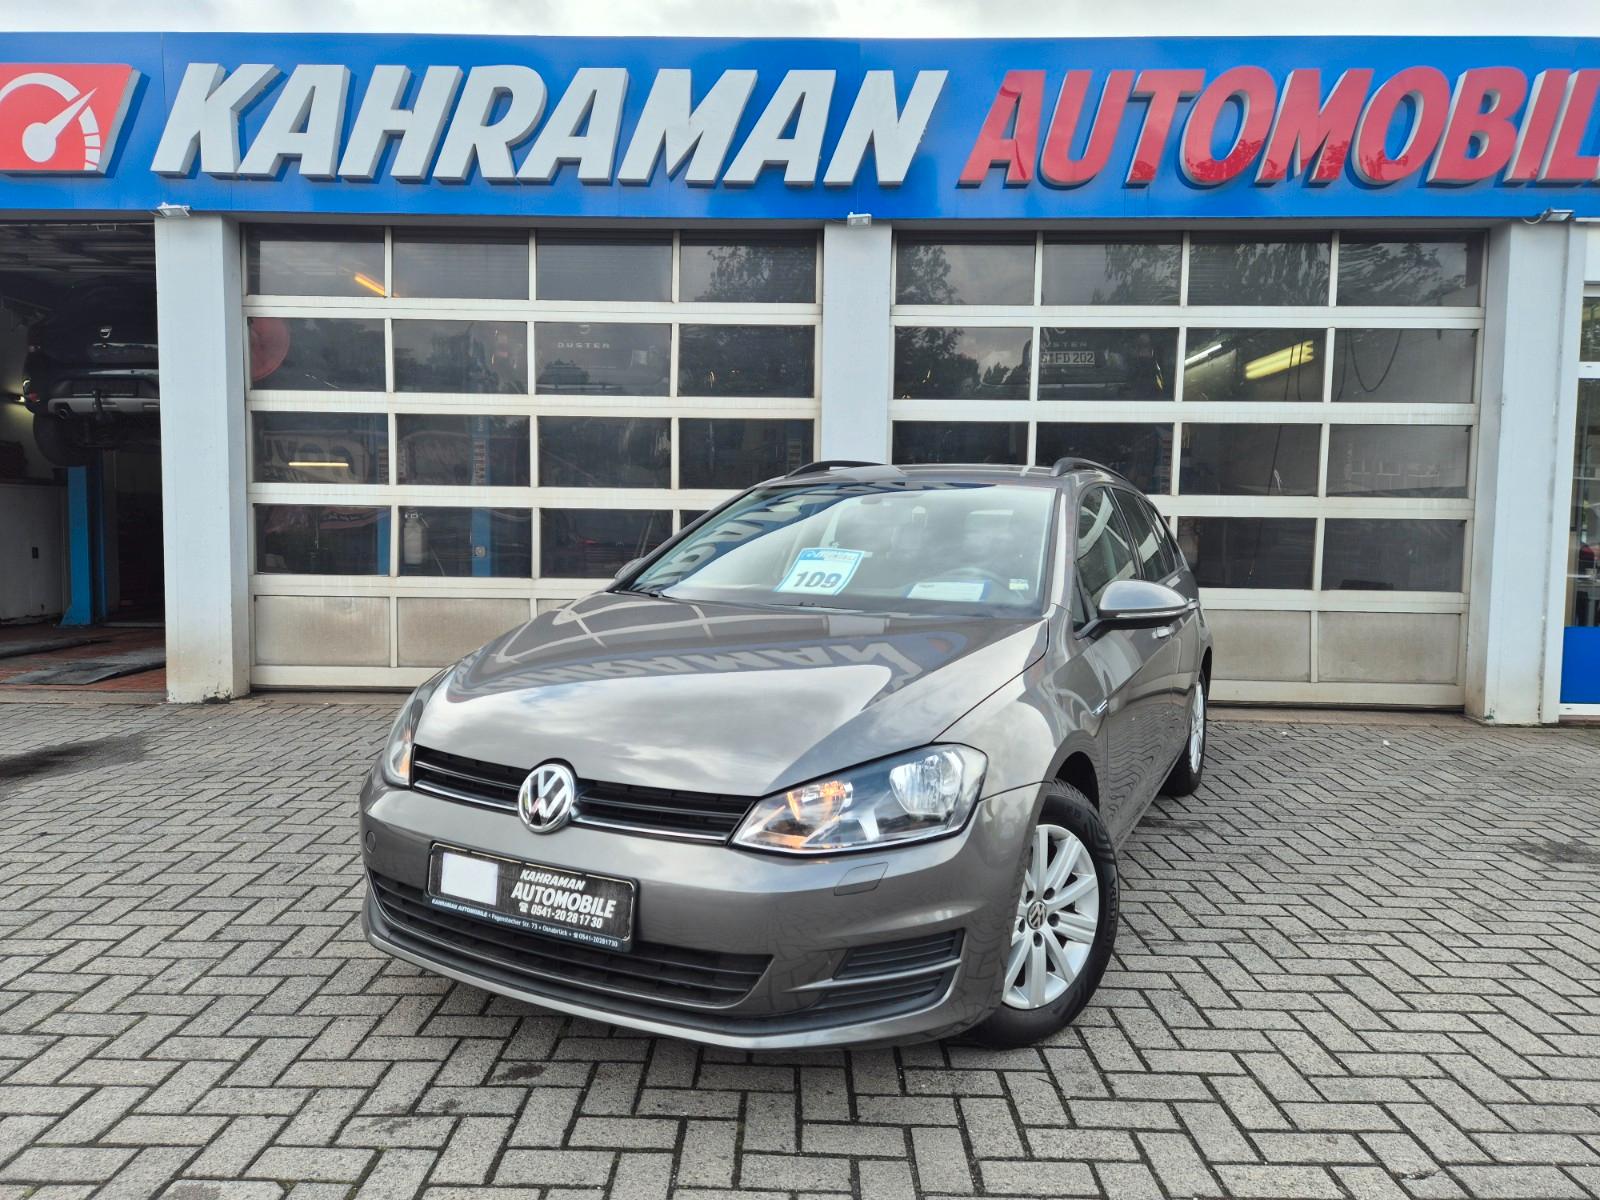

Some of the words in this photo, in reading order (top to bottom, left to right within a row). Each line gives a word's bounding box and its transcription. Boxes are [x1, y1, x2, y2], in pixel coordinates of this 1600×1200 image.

[151, 63, 948, 187] KAHRAMAN
[956, 65, 1600, 188] AUTOMOBIL
[793, 571, 842, 588] 109
[520, 764, 575, 834] VW
[520, 869, 586, 891] KAHRAMAN
[431, 898, 458, 909] KAHRAMAN
[457, 905, 488, 917] AUTOMOBILE
[510, 880, 617, 918] AUTOMOBILE
